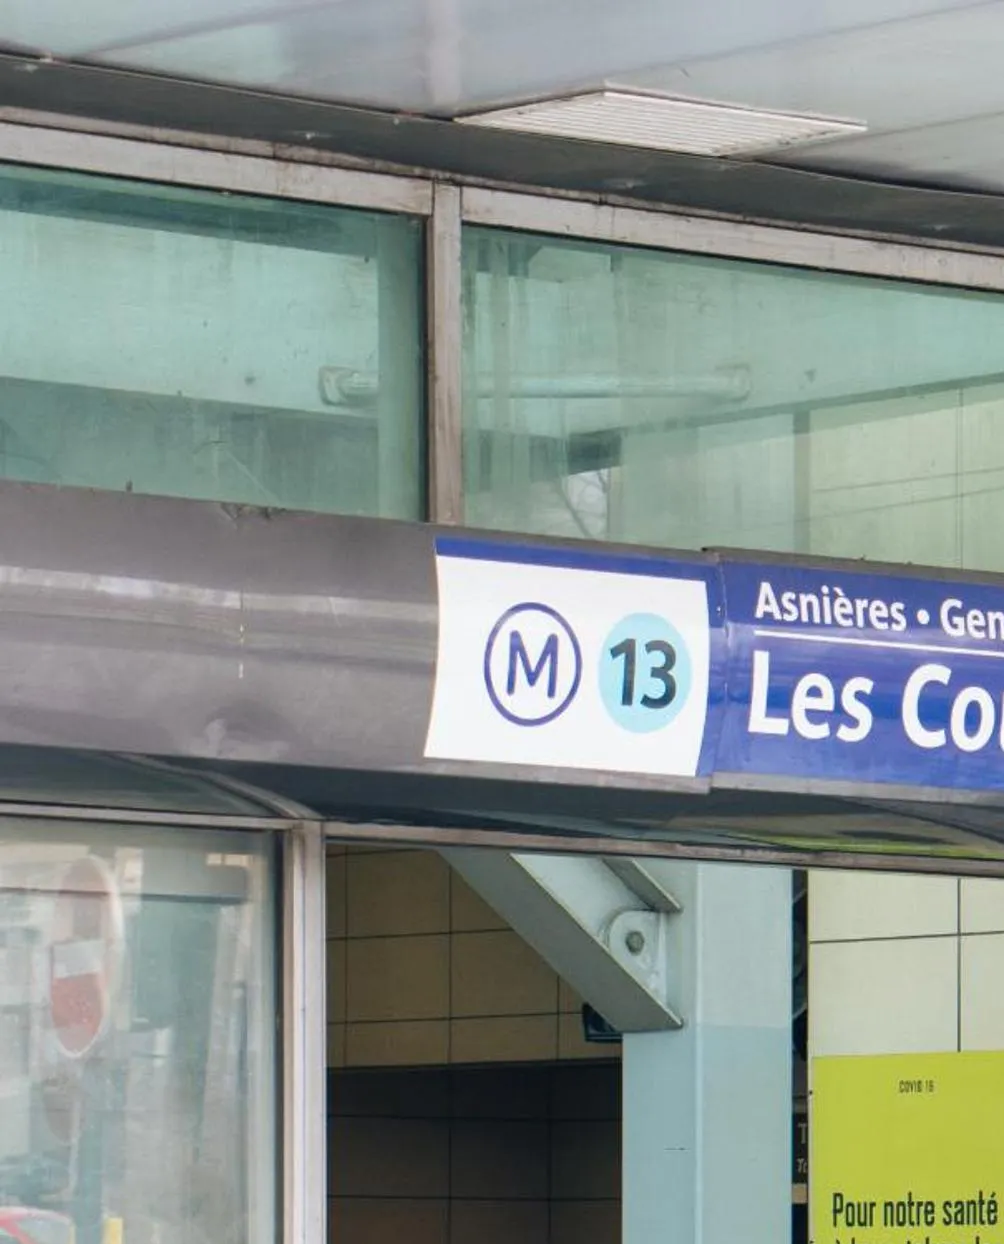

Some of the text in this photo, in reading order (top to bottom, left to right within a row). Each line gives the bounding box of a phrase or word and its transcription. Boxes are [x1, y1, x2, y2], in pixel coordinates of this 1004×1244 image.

[755, 581, 908, 632] Asnières
[609, 638, 677, 709] 13
[747, 649, 875, 743] Les
[899, 1079, 922, 1093] COVID
[832, 1190, 999, 1228] Pour notre santé
